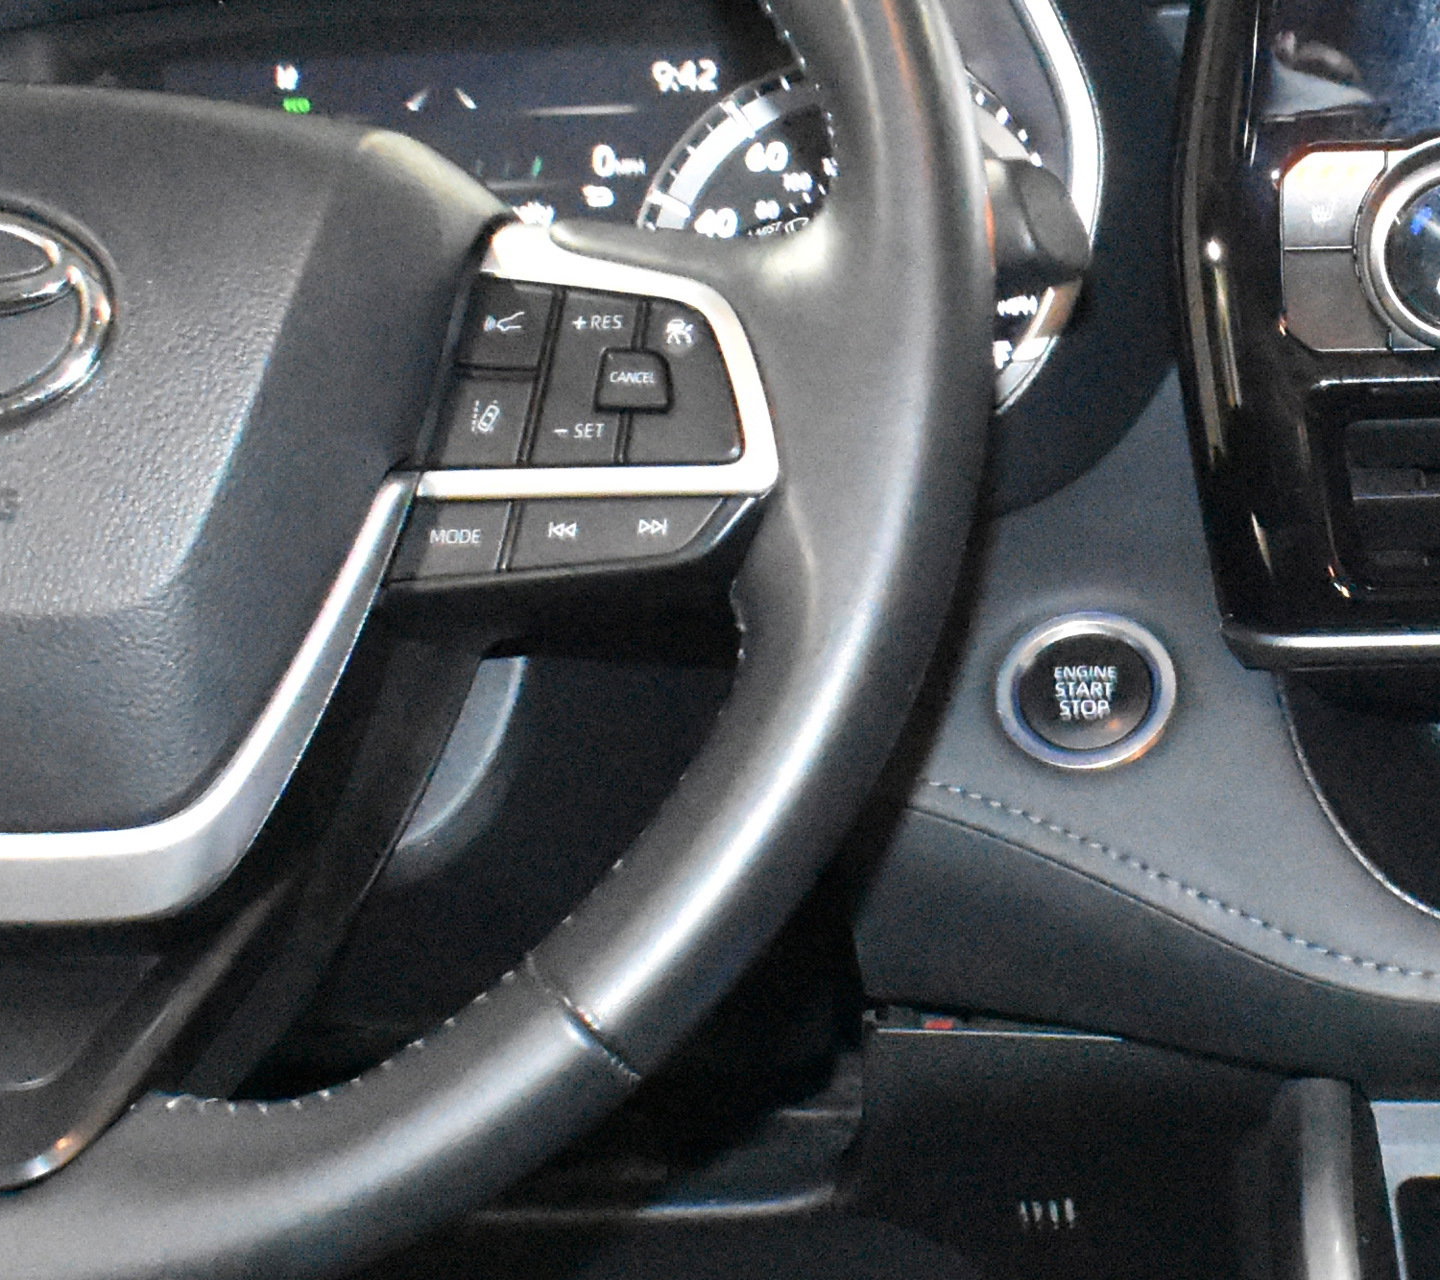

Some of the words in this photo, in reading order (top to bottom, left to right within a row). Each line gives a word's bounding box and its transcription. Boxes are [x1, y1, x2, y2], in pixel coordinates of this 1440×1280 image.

[652, 60, 718, 93] 9:42
[745, 141, 789, 172] 60
[693, 208, 738, 238] 40
[609, 368, 657, 386] CANCEL
[429, 526, 482, 546] MODE
[1054, 665, 1117, 682] ENGINE
[1055, 682, 1112, 698] START
[1059, 699, 1110, 717] STOP
